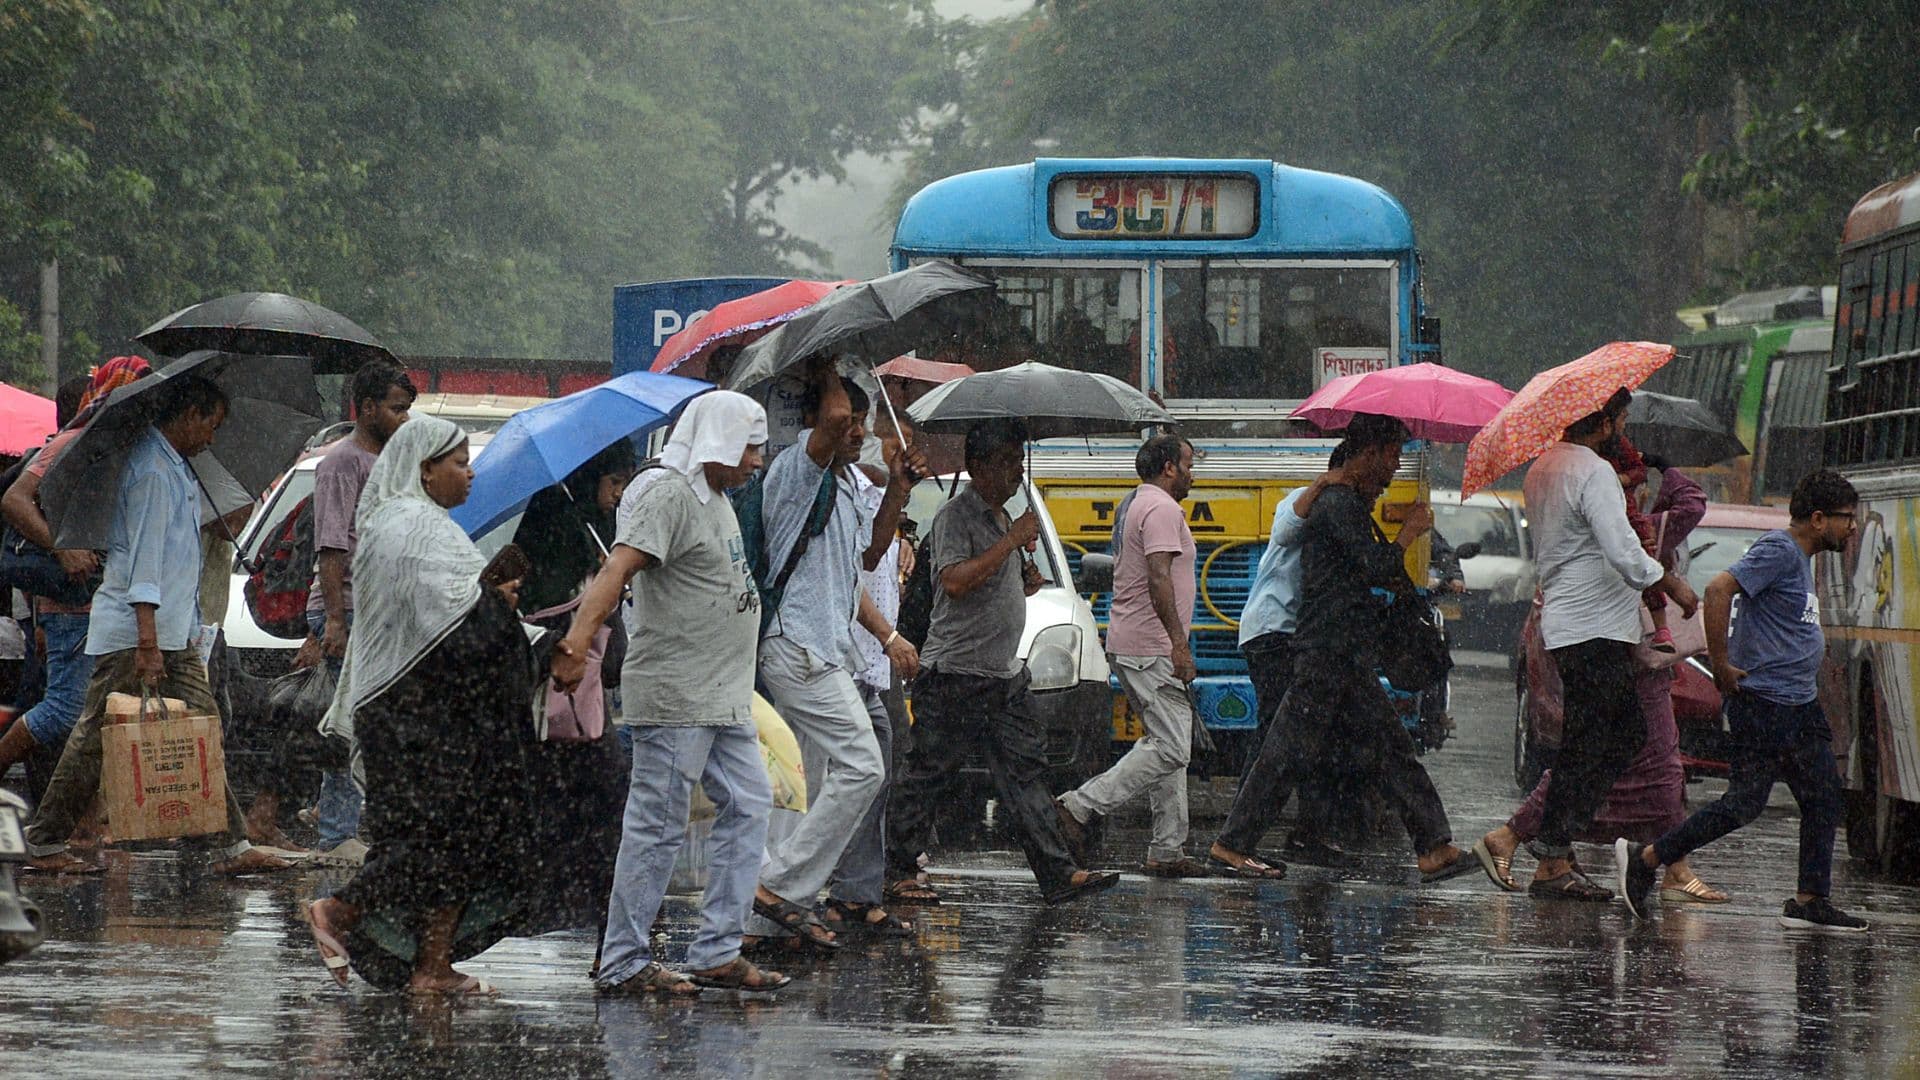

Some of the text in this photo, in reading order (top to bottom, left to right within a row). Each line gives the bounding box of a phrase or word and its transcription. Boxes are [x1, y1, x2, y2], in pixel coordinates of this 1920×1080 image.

[1075, 178, 1218, 235] 3C/1
[1091, 501, 1215, 522] TA
[145, 785, 161, 794] FAN
